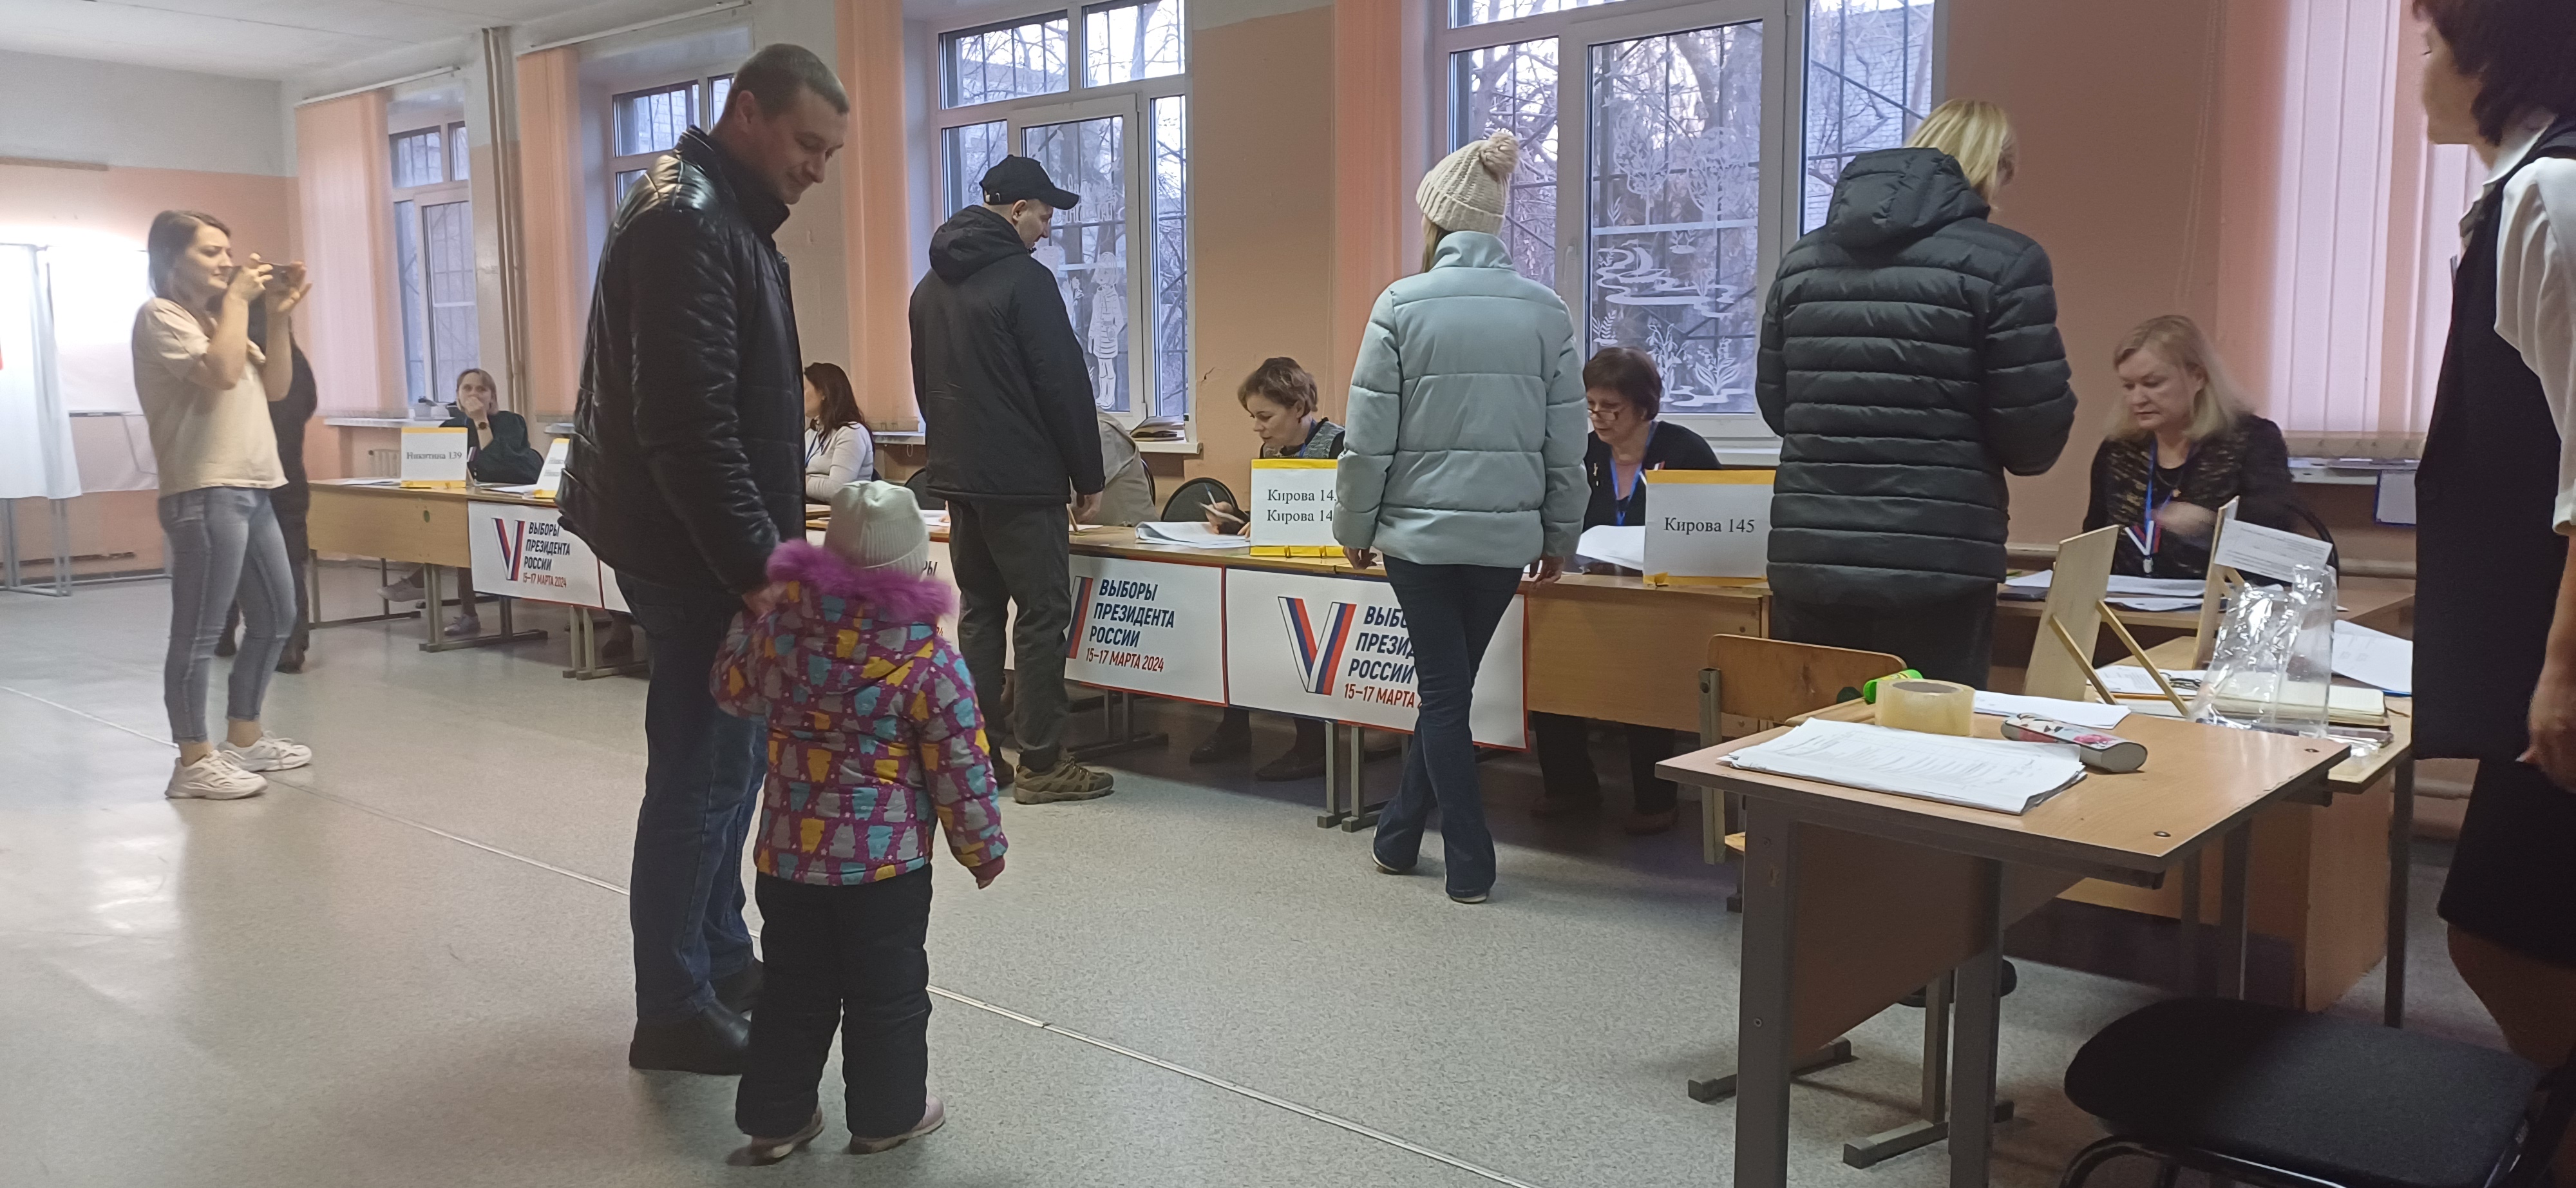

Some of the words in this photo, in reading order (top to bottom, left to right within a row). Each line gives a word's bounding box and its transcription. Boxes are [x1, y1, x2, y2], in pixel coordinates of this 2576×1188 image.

[1267, 489, 1314, 504] Кирова
[1320, 490, 1336, 501] 14
[1267, 510, 1314, 524] Кирова
[1663, 517, 1721, 535] Кирова
[1728, 519, 1755, 533] 145
[529, 522, 560, 537] ВЫБОРЫ
[526, 539, 570, 555] ПРЕЗИДЕНТА
[524, 556, 552, 571] РОССИИ
[537, 574, 554, 586] МАРТА
[554, 576, 567, 588] 2024
[1099, 579, 1158, 601] ВЫБОРЫ
[1094, 602, 1175, 628] ПРЕЗИДЕНТА
[1089, 626, 1141, 647] РОССИИ
[1109, 651, 1141, 669] МАРТА
[1142, 655, 1164, 672] 2024
[1348, 658, 1415, 684] РОССИИ
[1376, 687, 1415, 708] МАРТА
